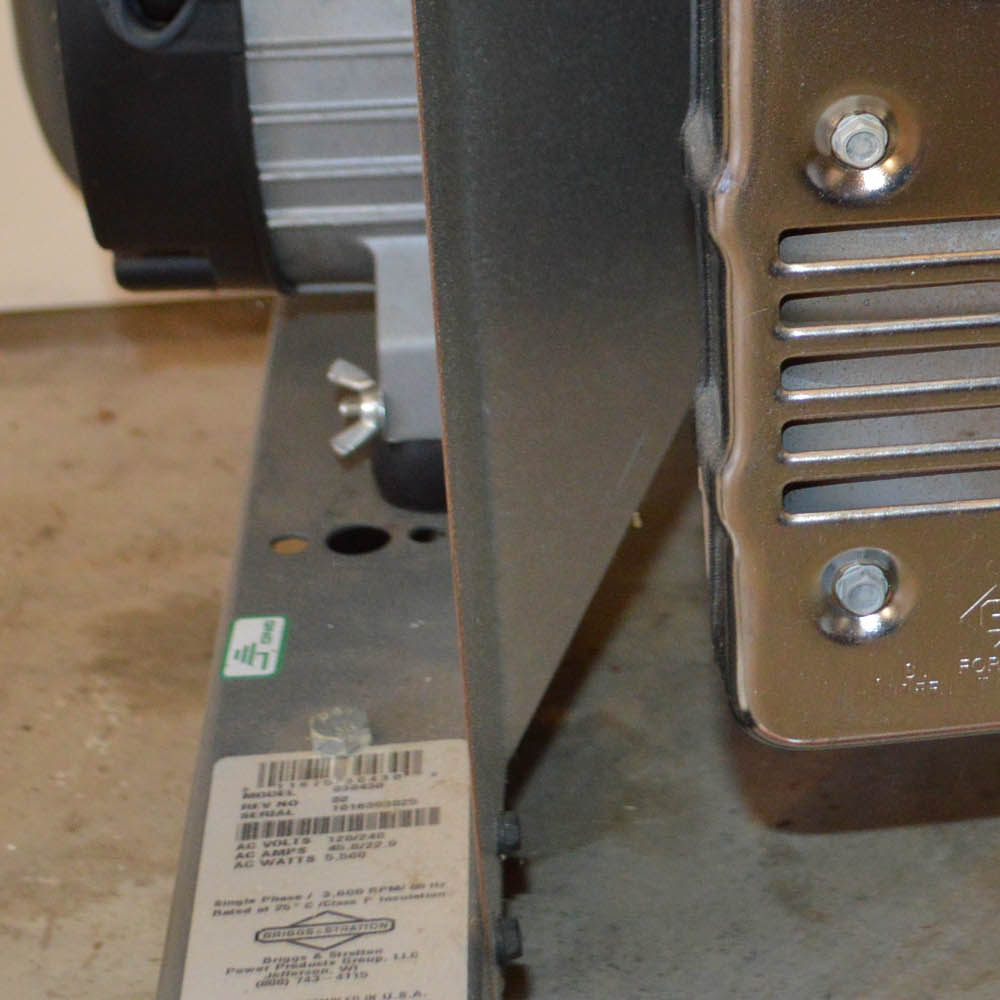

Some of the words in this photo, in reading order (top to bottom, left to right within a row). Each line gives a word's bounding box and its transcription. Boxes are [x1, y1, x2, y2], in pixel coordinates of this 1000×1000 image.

[242, 789, 296, 799] MODEL
[241, 801, 272, 811] REV
[277, 799, 298, 808] NO
[241, 808, 296, 819] SERIAL
[236, 841, 257, 851] AC
[263, 836, 312, 848] VOLTS
[235, 850, 256, 860] AC
[261, 846, 307, 857] AMPS
[233, 859, 256, 869] AC
[259, 854, 316, 867] WATTS
[263, 926, 314, 939] BRIGGS
[324, 920, 389, 934] STRATTON
[263, 954, 307, 967] Briggs
[329, 947, 384, 959] Stratton
[223, 964, 270, 976] Power
[275, 960, 335, 971] Products
